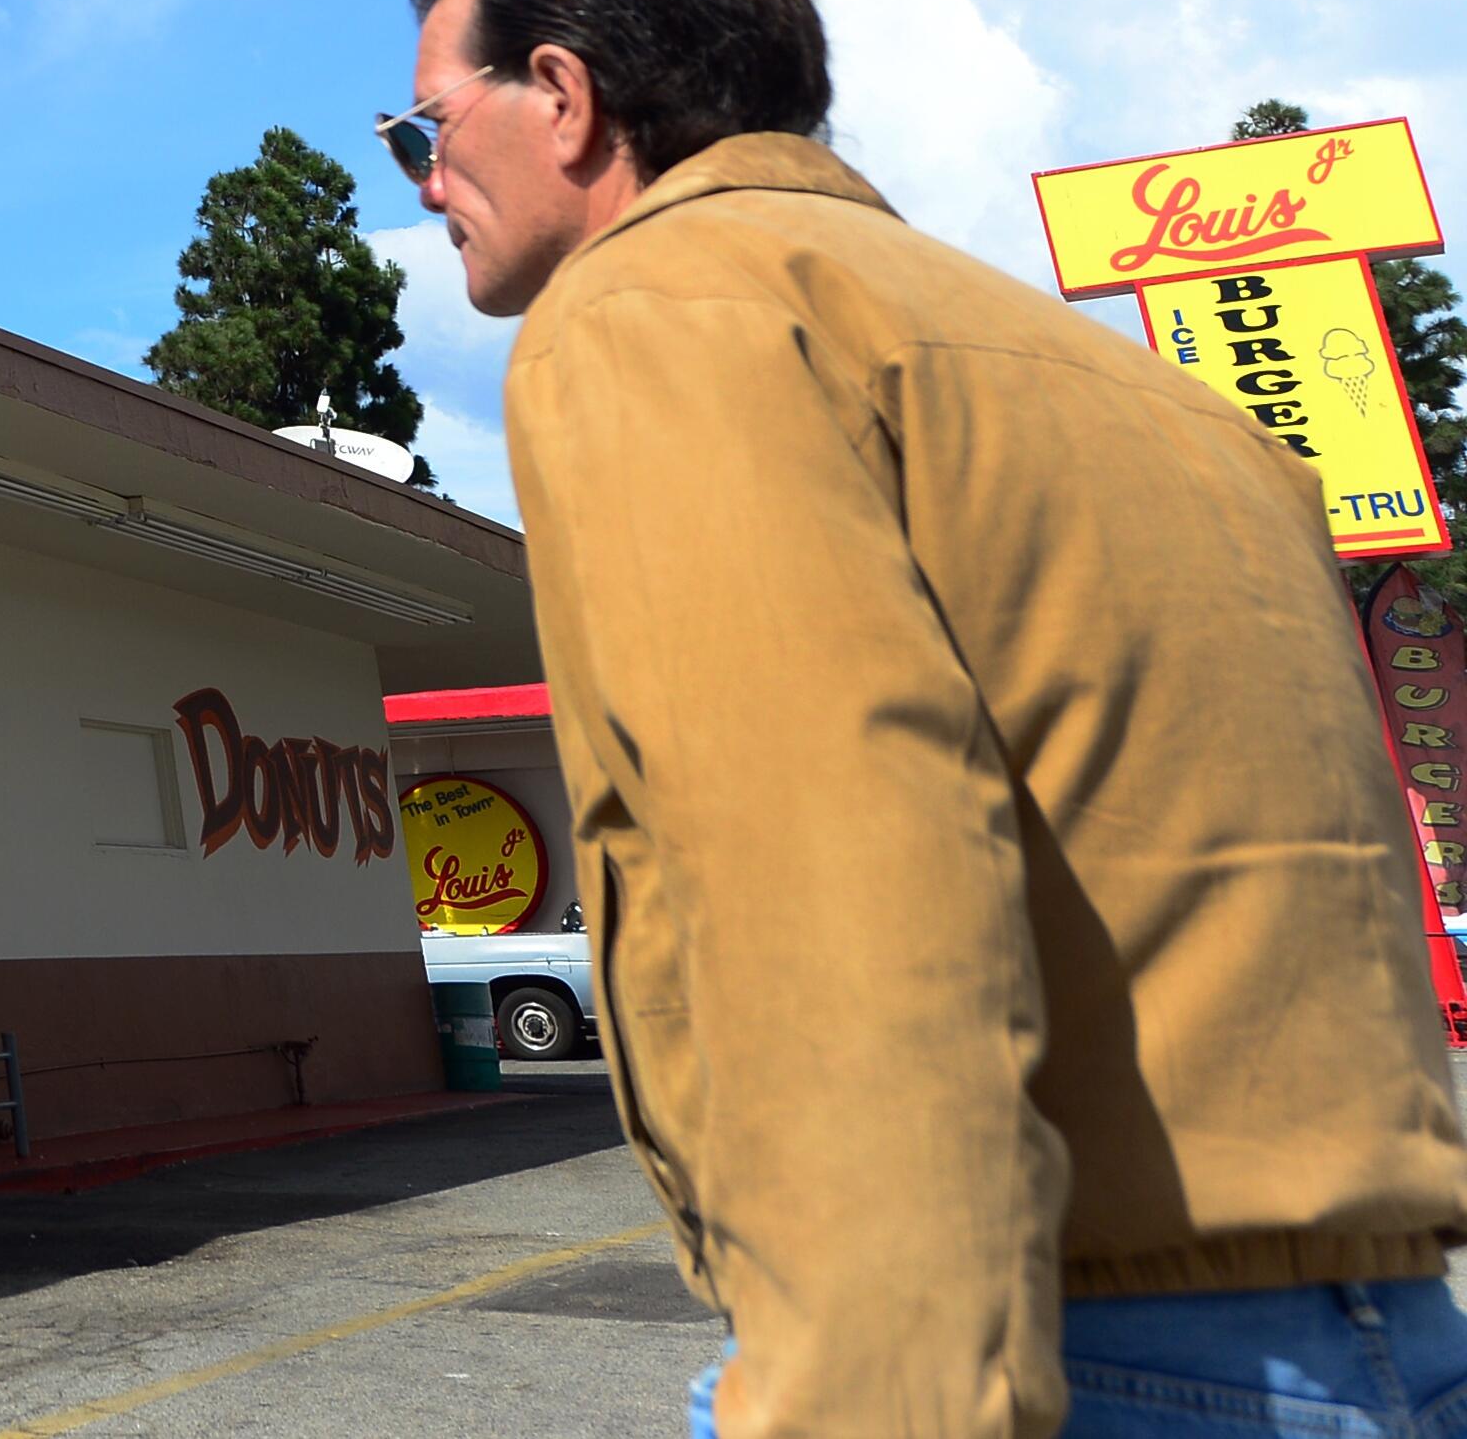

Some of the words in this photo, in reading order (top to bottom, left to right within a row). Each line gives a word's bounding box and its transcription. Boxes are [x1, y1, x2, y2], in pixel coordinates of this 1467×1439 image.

[1307, 138, 1355, 184] Jr
[1110, 164, 1332, 272] Louis
[1173, 309, 1200, 364] ICE
[172, 687, 395, 868] DONUTS
[435, 783, 471, 806] Best
[1391, 644, 1466, 905] BURGERS
[434, 812, 450, 827] in
[416, 845, 528, 916] Louis
